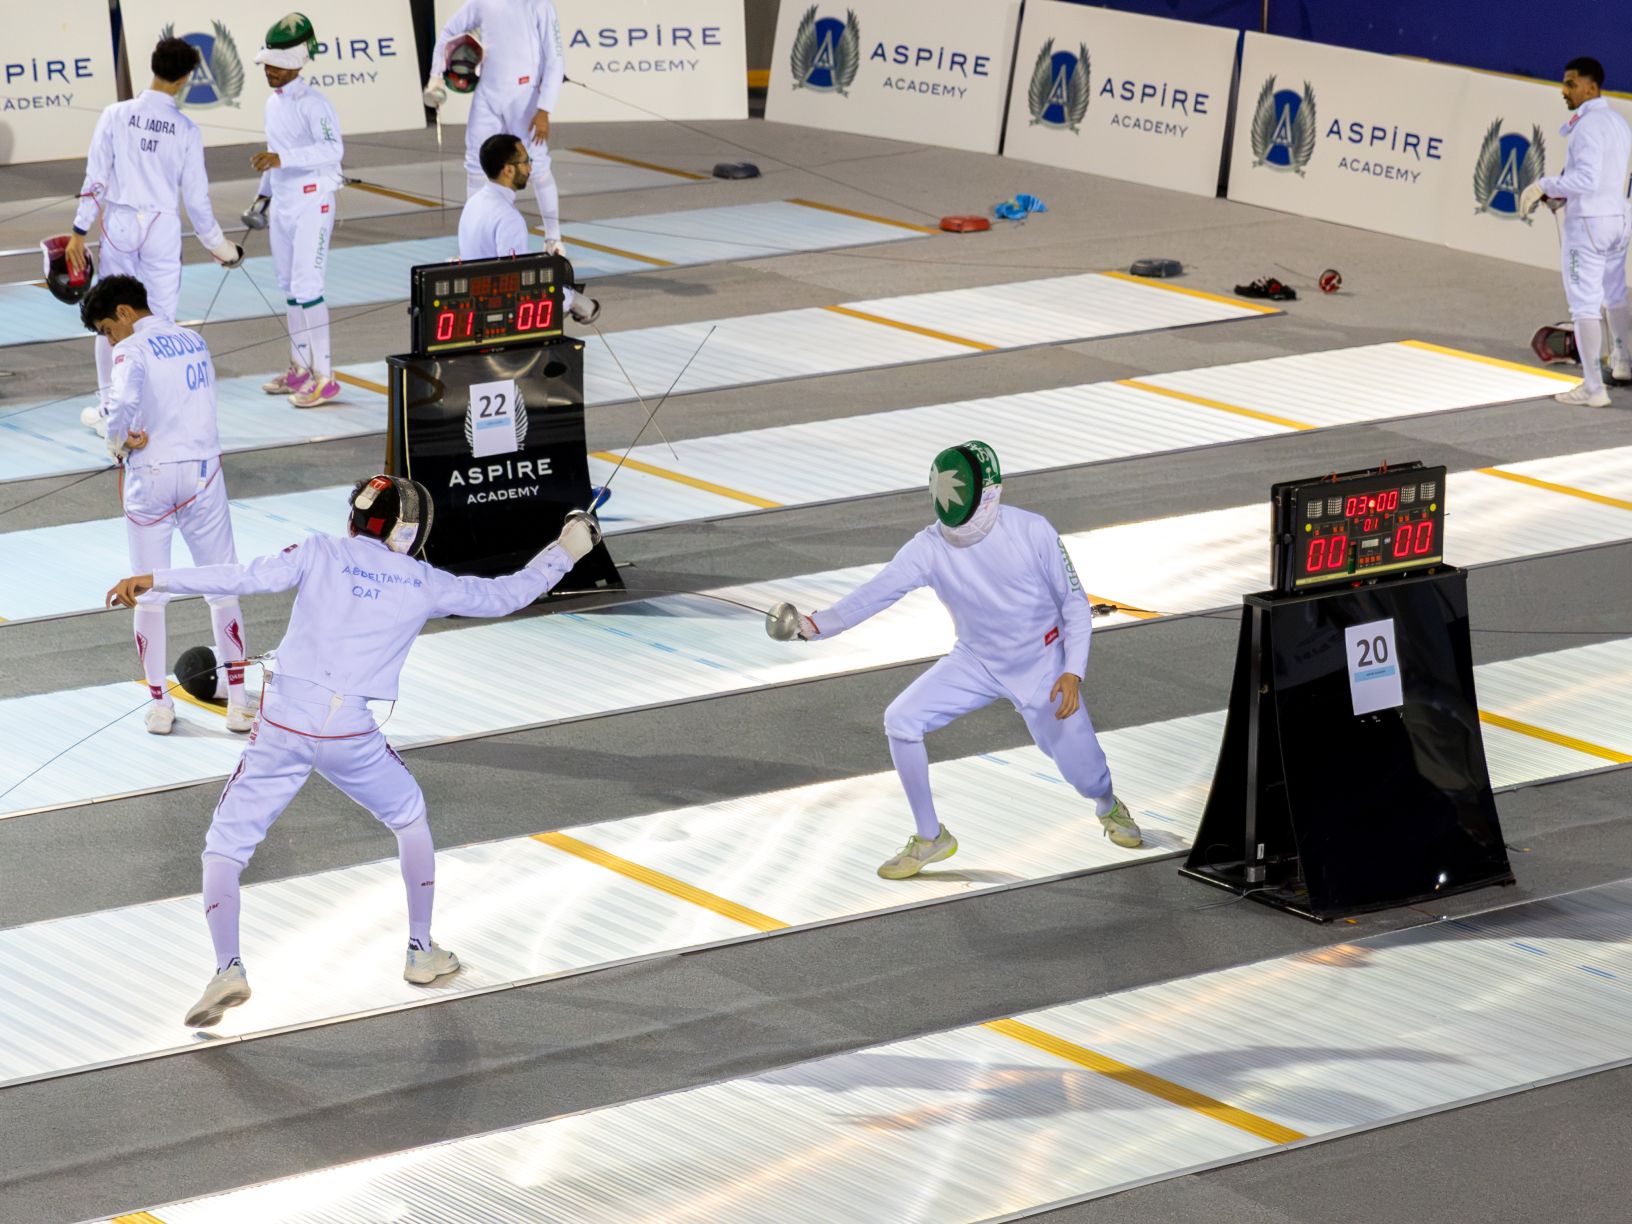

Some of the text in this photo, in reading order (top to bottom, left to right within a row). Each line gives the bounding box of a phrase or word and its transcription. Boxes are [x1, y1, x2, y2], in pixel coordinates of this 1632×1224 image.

[316, 36, 397, 62] PIRE
[5, 57, 94, 85] PIRE
[592, 59, 700, 73] ACADEMY
[308, 71, 378, 88] ADEMY
[883, 76, 967, 99] ACADEMY
[3, 93, 74, 112] ADEMY
[128, 114, 176, 136] AL JADRA
[1110, 113, 1189, 138] ACADEMY
[140, 137, 159, 153] QAT
[1338, 156, 1422, 184] ACADEMY
[517, 300, 553, 331] 00
[479, 393, 507, 419] 22
[467, 485, 540, 505] ACADEMY
[1393, 521, 1434, 557] 00
[1306, 535, 1347, 573] 00
[352, 585, 381, 600] QAT
[1356, 635, 1388, 667] 20
